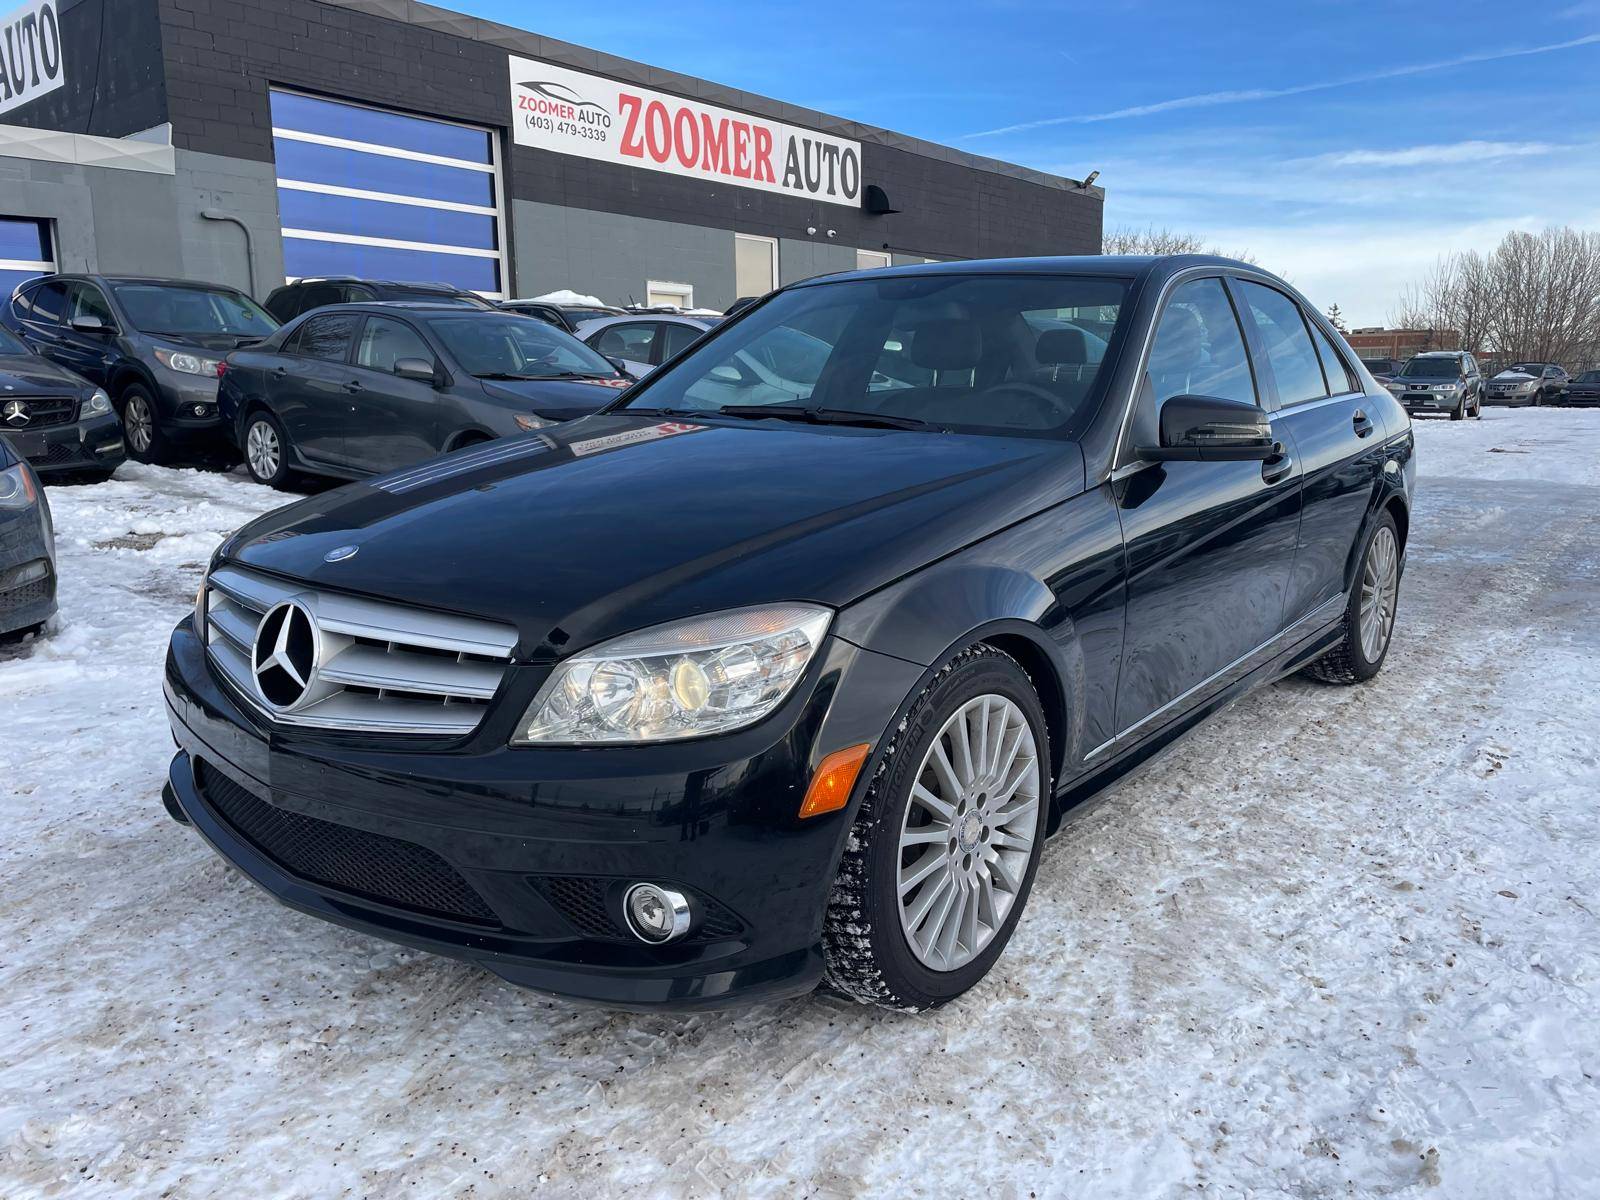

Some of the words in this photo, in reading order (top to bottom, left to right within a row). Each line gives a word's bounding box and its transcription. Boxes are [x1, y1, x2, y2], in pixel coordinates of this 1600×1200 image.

[518, 95, 575, 121] ZOOMER
[578, 109, 611, 128] AUTO
[525, 114, 554, 133] (403)
[557, 121, 606, 142] 479-3339
[618, 93, 775, 183] ZOOMER
[782, 134, 859, 199] AUTO
